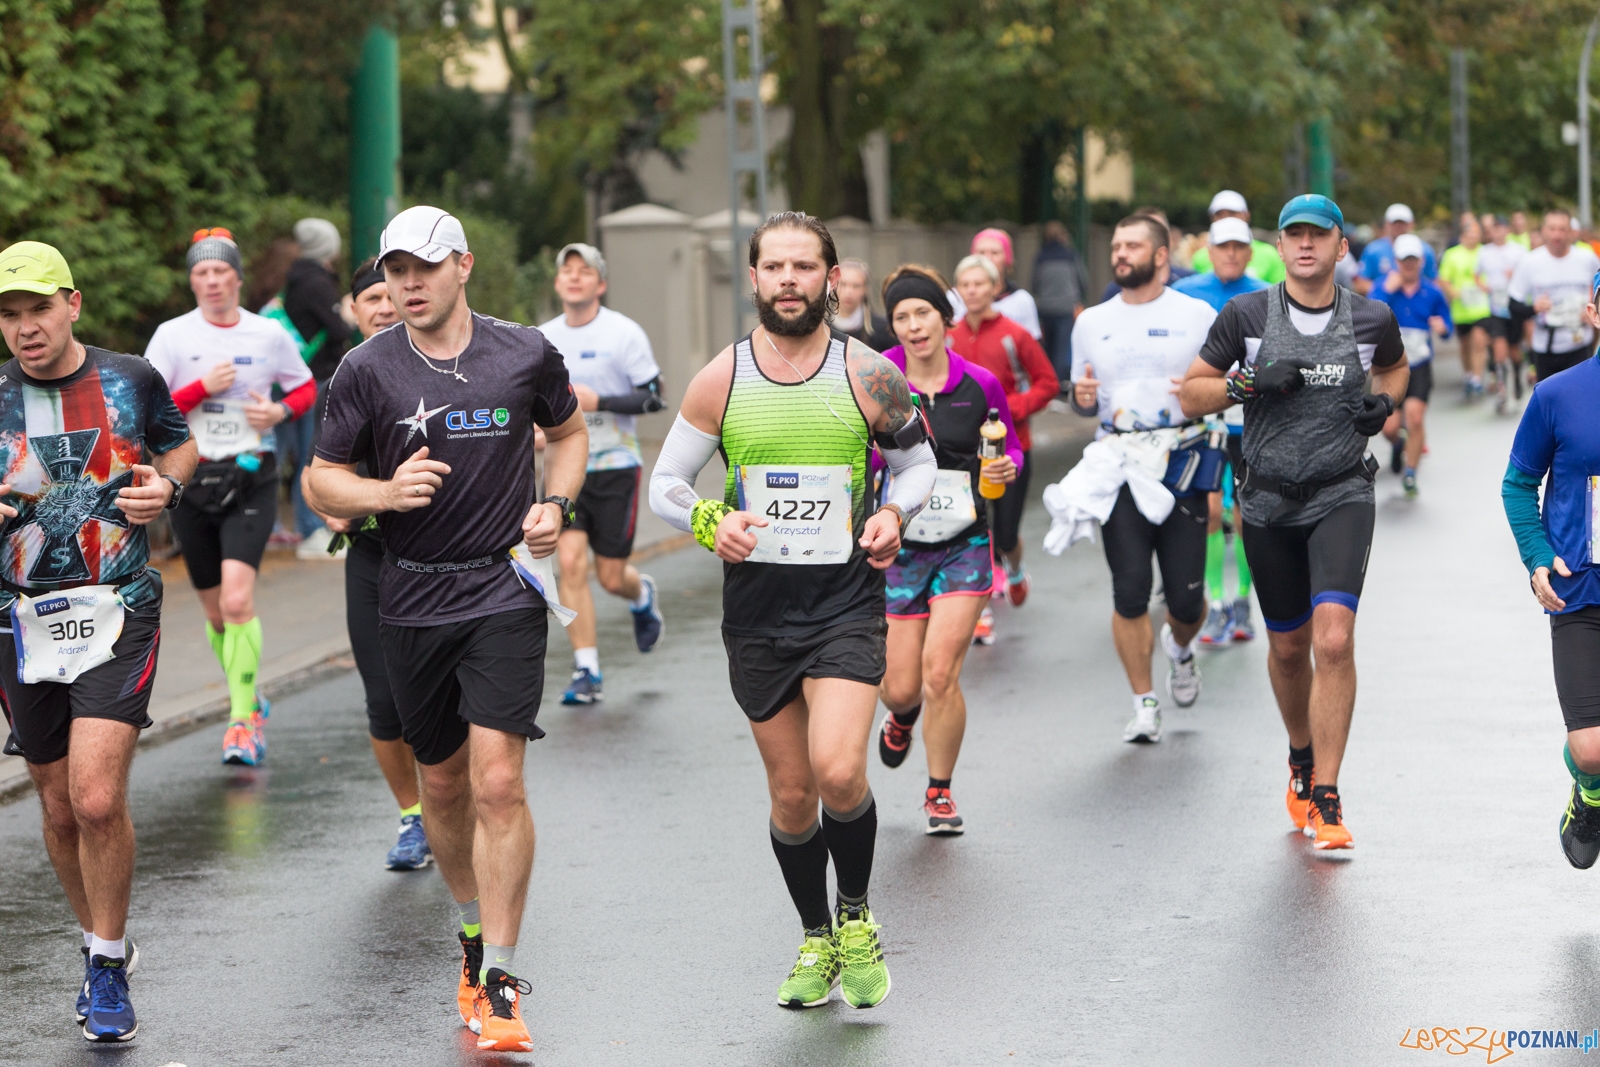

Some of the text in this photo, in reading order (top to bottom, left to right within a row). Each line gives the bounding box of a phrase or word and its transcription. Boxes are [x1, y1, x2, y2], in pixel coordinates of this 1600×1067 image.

[445, 409, 491, 430] CLS
[768, 477, 797, 485] 17.PKO
[766, 500, 831, 520] 4227
[773, 526, 821, 537] Krzysztof
[397, 560, 434, 573] NOWE
[437, 560, 493, 573] GRANICE
[38, 601, 67, 612] 17.PKO
[49, 618, 95, 641] 306
[58, 643, 88, 655] Andrzej
